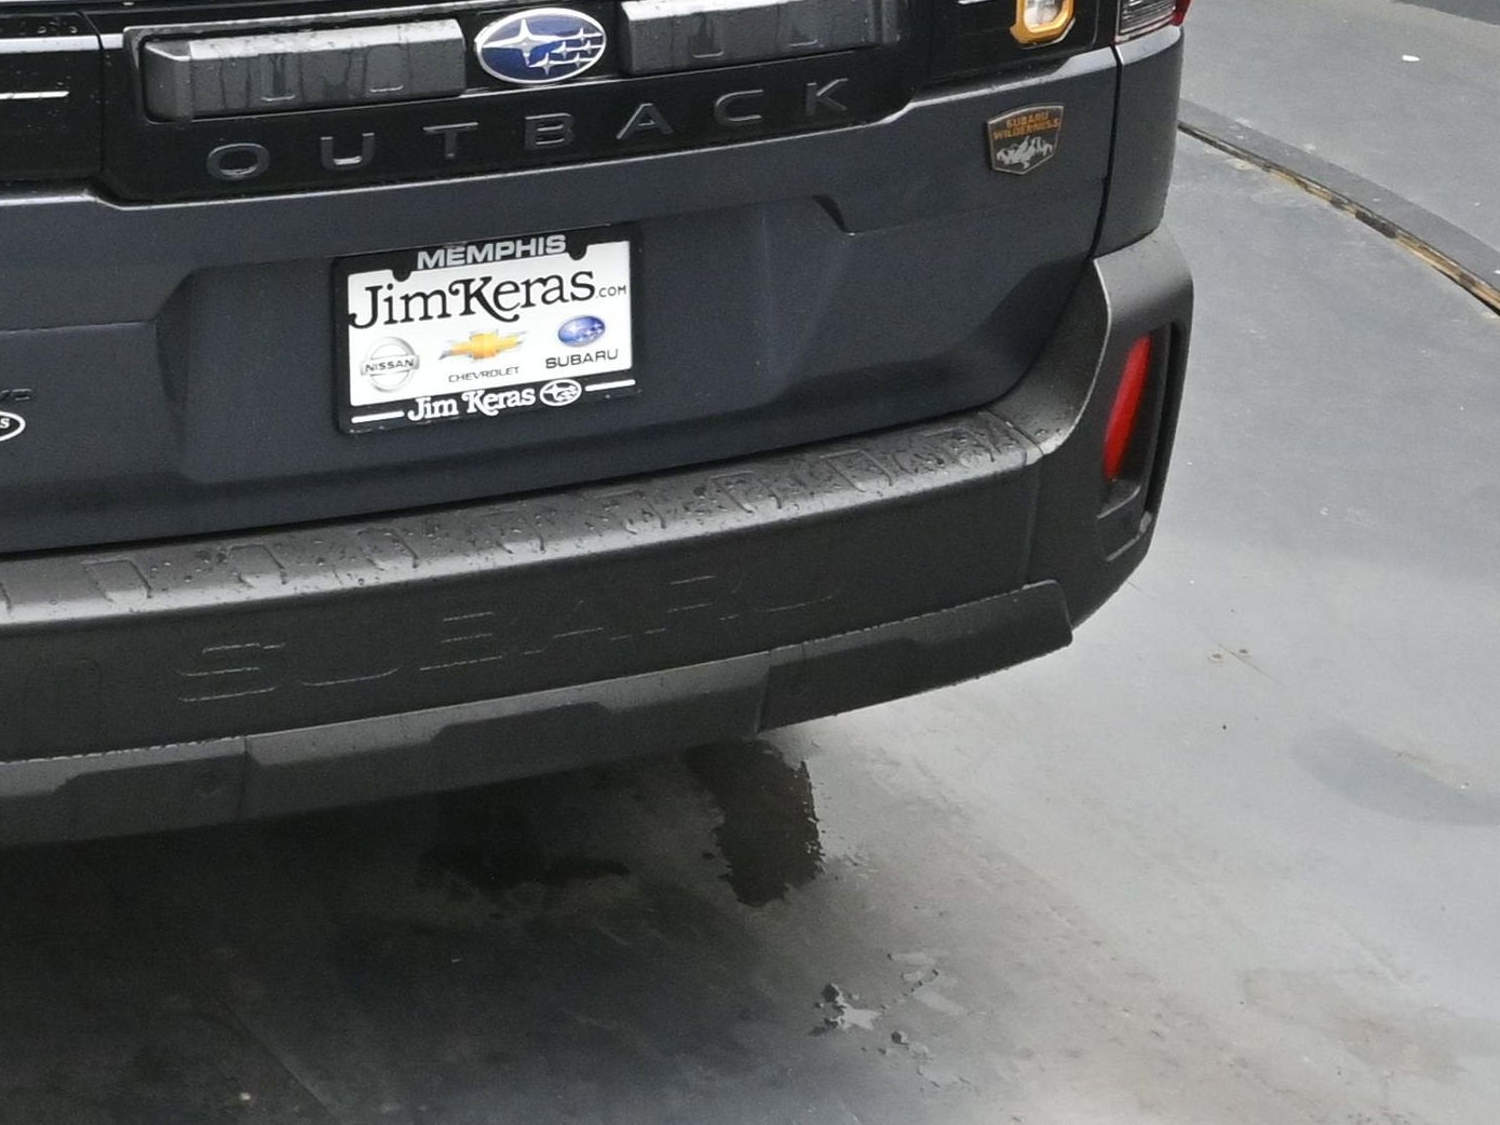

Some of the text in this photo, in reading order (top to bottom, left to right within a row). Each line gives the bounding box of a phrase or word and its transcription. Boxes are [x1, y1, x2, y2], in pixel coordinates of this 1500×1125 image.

[206, 77, 850, 179] OUTBACK
[416, 234, 567, 269] MEMPHIS
[364, 356, 416, 372] NISSAN
[545, 348, 619, 369] SUBARU
[448, 366, 520, 384] CHEVROLET
[406, 388, 537, 421] Jim Keras
